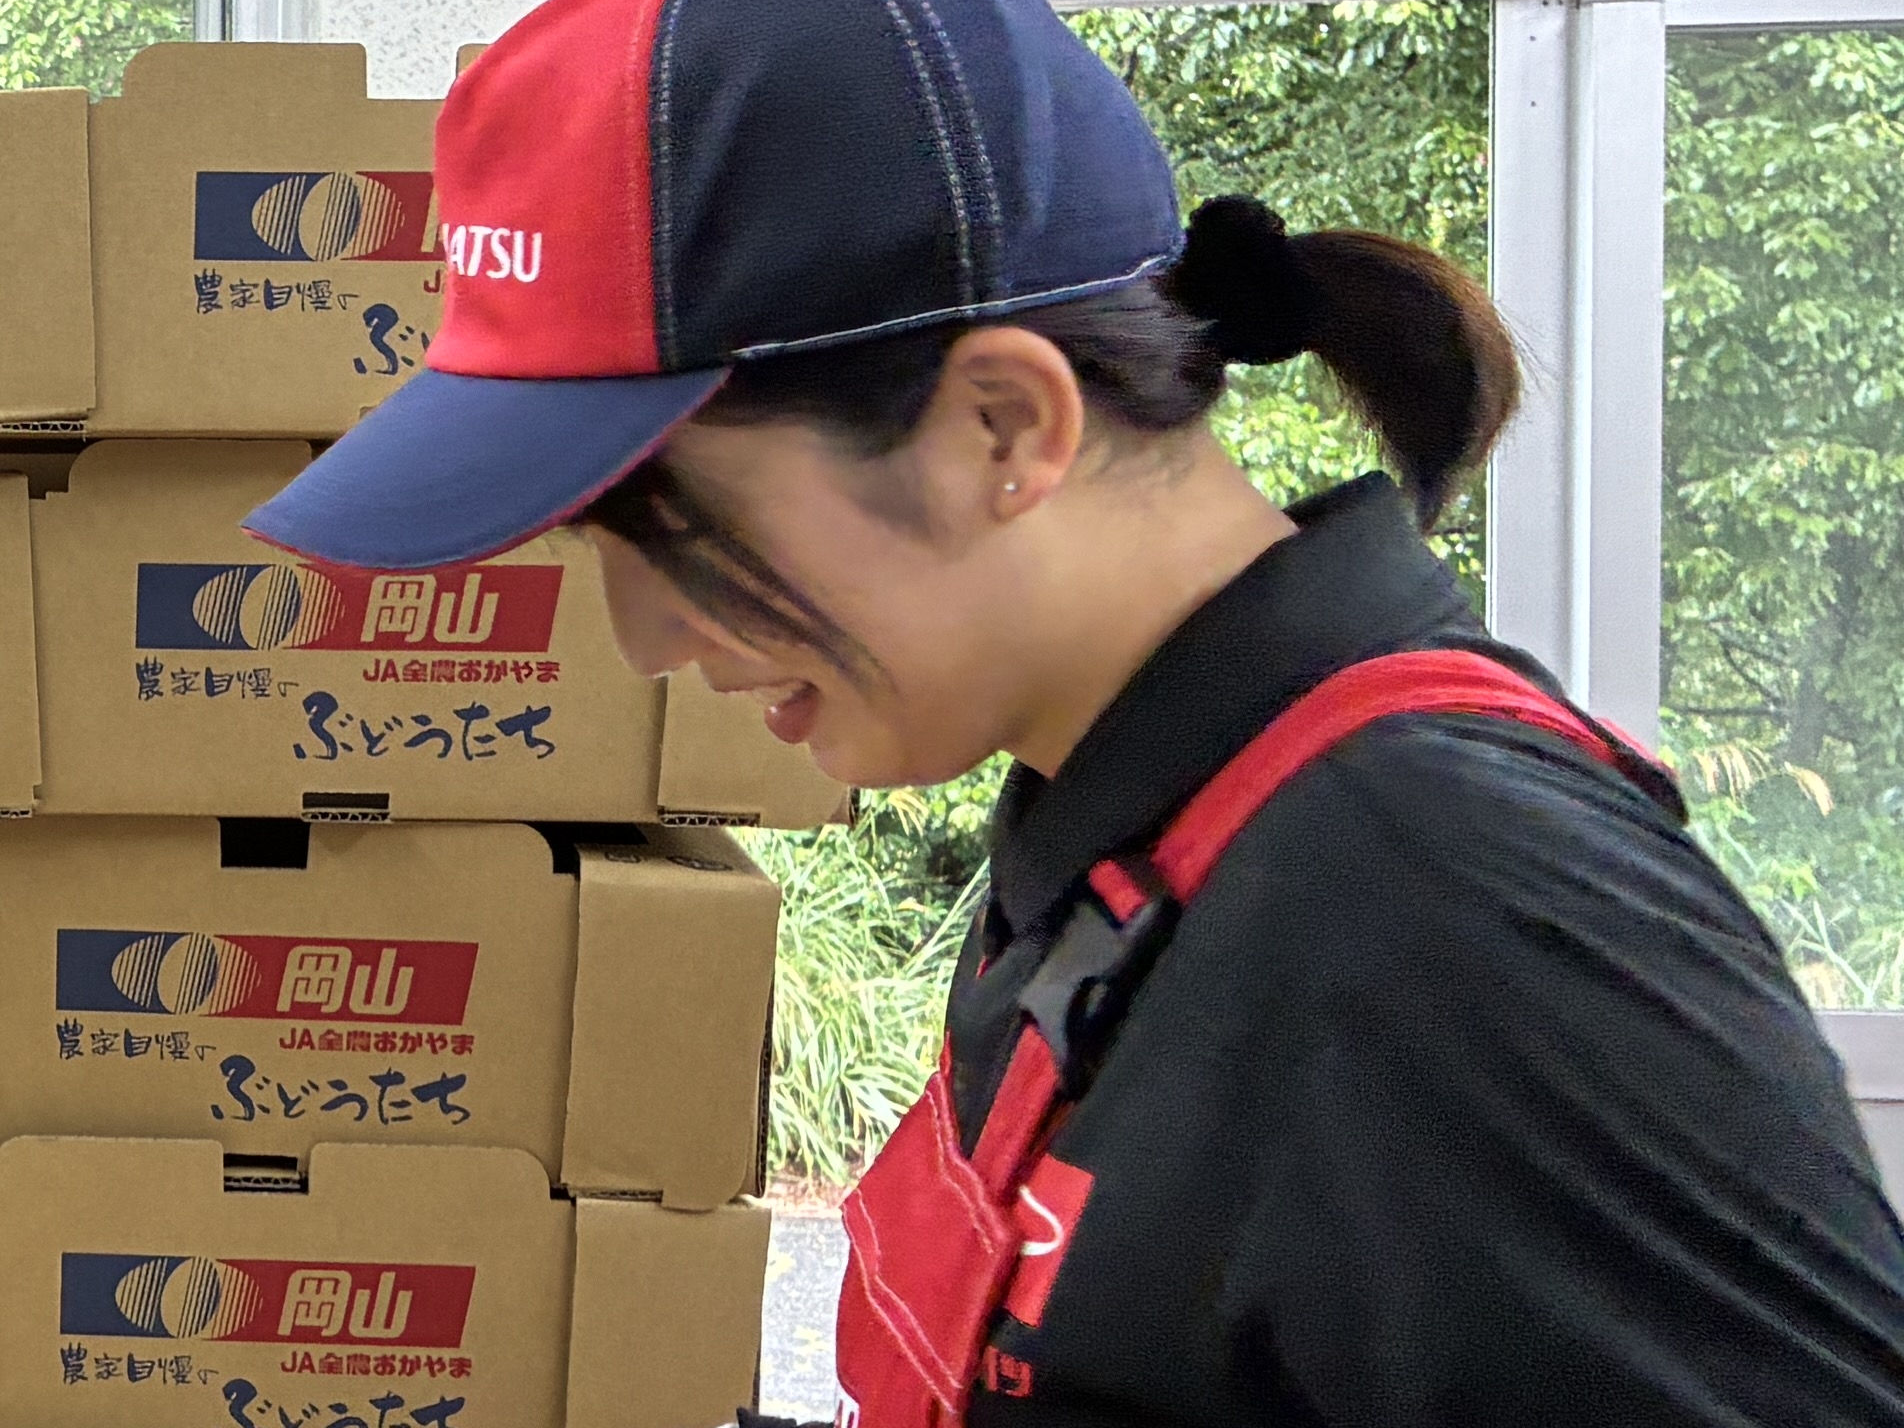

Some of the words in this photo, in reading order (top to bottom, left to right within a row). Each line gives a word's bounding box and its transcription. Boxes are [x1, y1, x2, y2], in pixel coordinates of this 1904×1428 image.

[194, 268, 360, 314] 農家自慢の
[360, 572, 499, 644] 岡山
[135, 656, 299, 700] 農家自慢の
[362, 659, 561, 684] JA全農おかやま
[293, 691, 556, 760] ぶどうたち
[276, 945, 414, 1015] 岡山
[56, 1018, 217, 1061] 農家自慢の
[279, 1028, 475, 1056] JA全農おかやま
[210, 1054, 471, 1125] ぶどうたち
[277, 1269, 413, 1338] 岡山
[60, 1342, 219, 1385] 農家自慢の
[280, 1351, 472, 1378] JA全農おかやま
